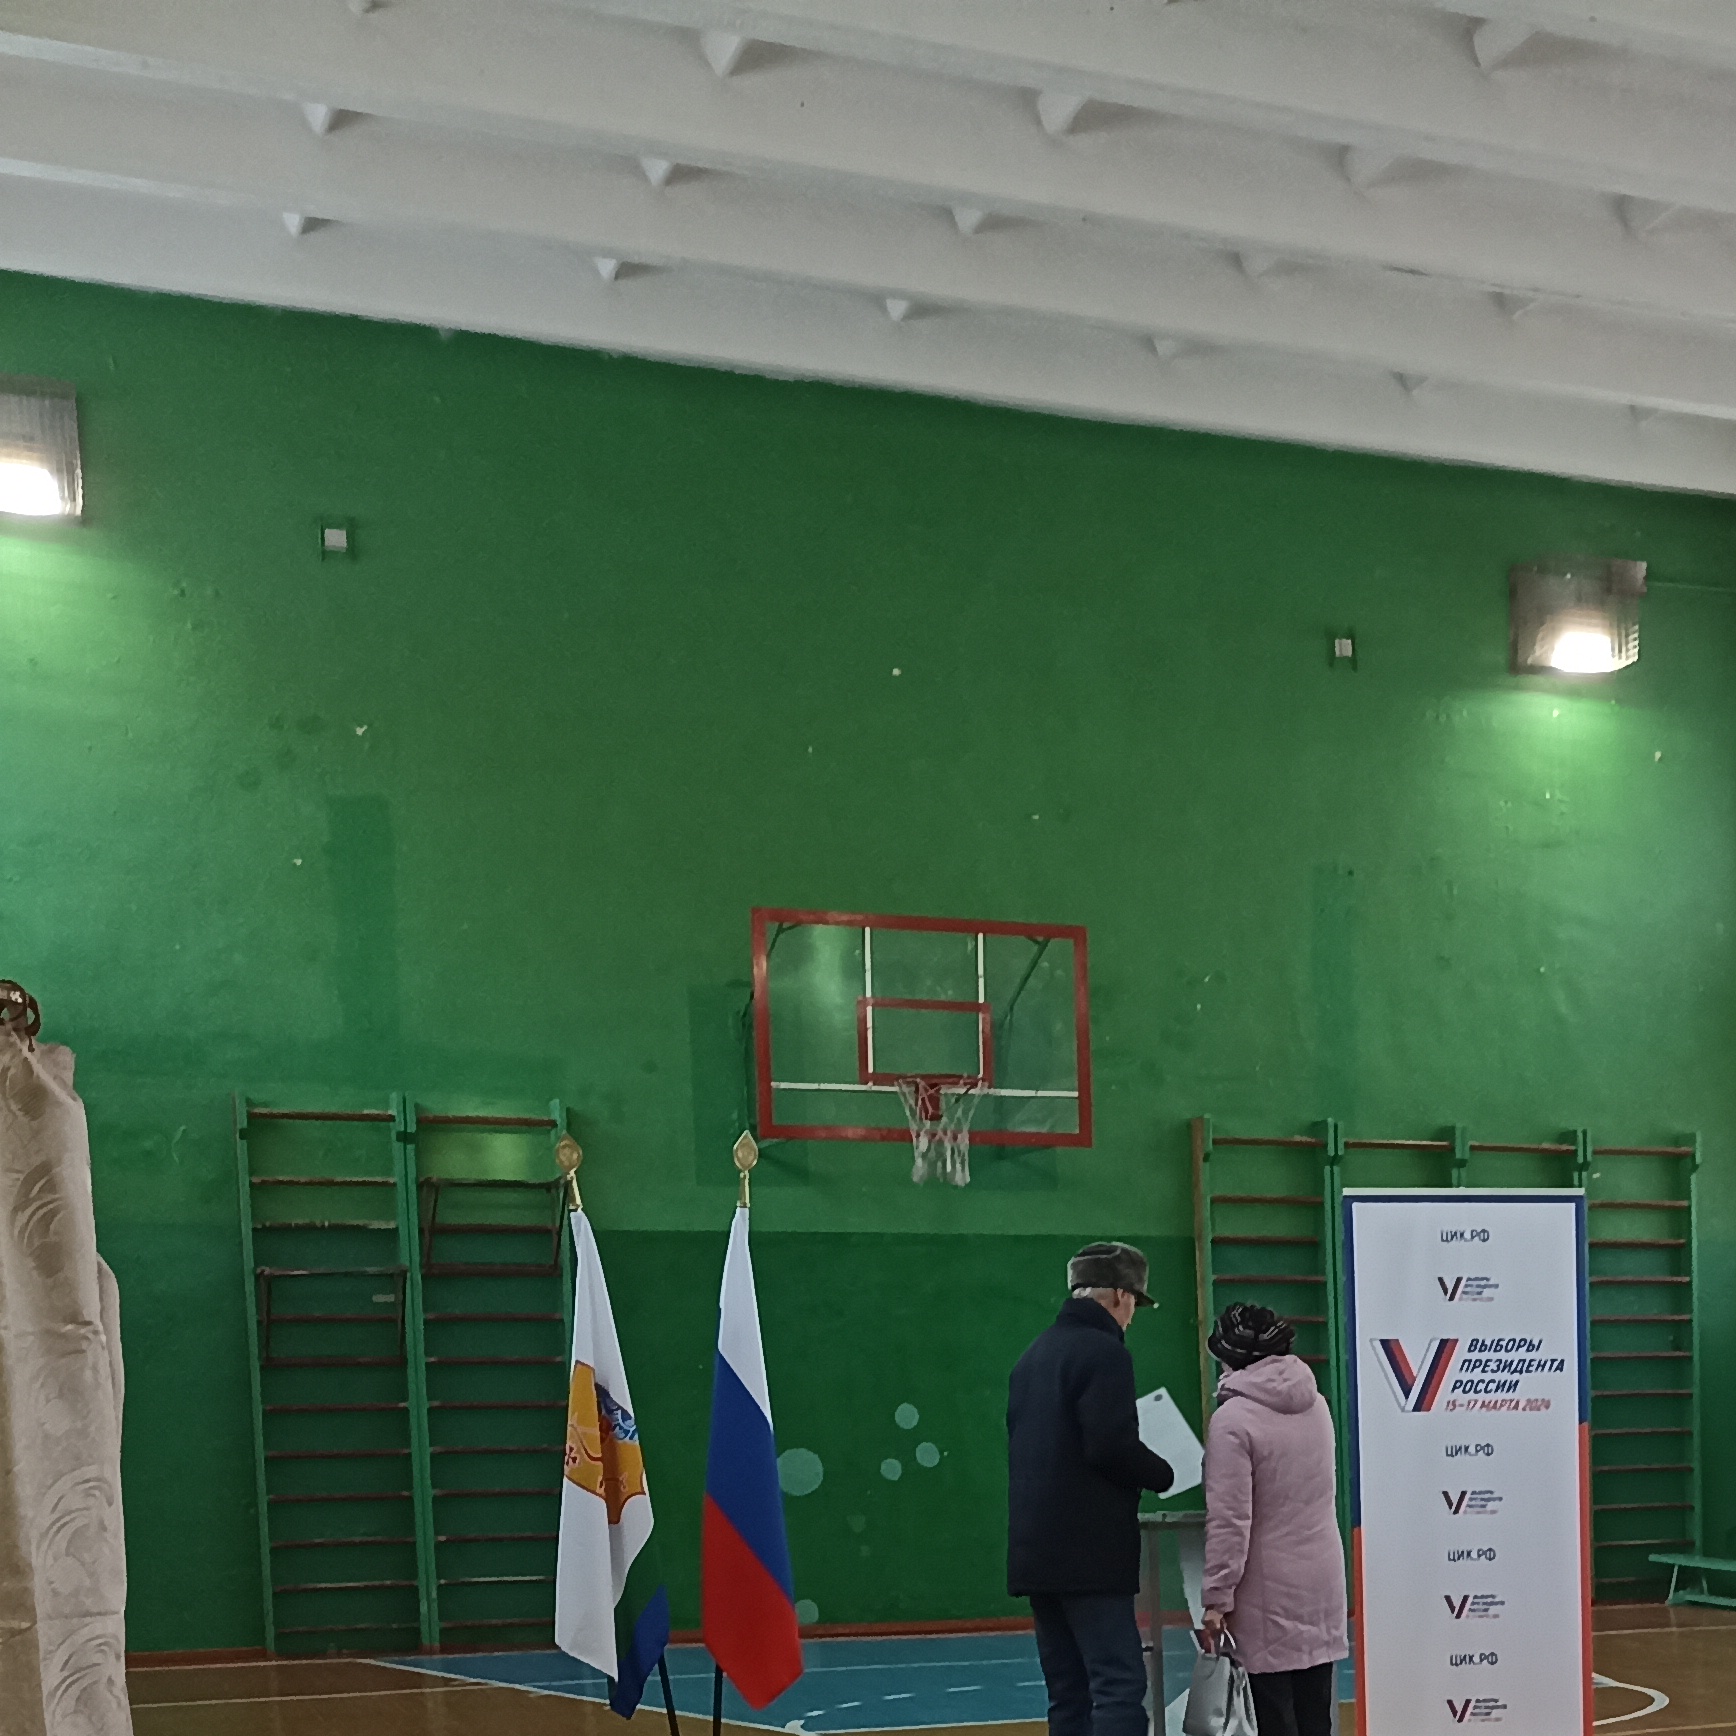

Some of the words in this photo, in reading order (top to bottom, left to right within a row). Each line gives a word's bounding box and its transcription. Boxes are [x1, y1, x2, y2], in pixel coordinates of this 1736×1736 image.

[1467, 1337, 1544, 1353] ВЫБОРЫ
[1459, 1358, 1566, 1375] ПРЕЗИДЕНТА
[1450, 1378, 1520, 1394] РОССИИ
[1479, 1398, 1521, 1412] МАРТА
